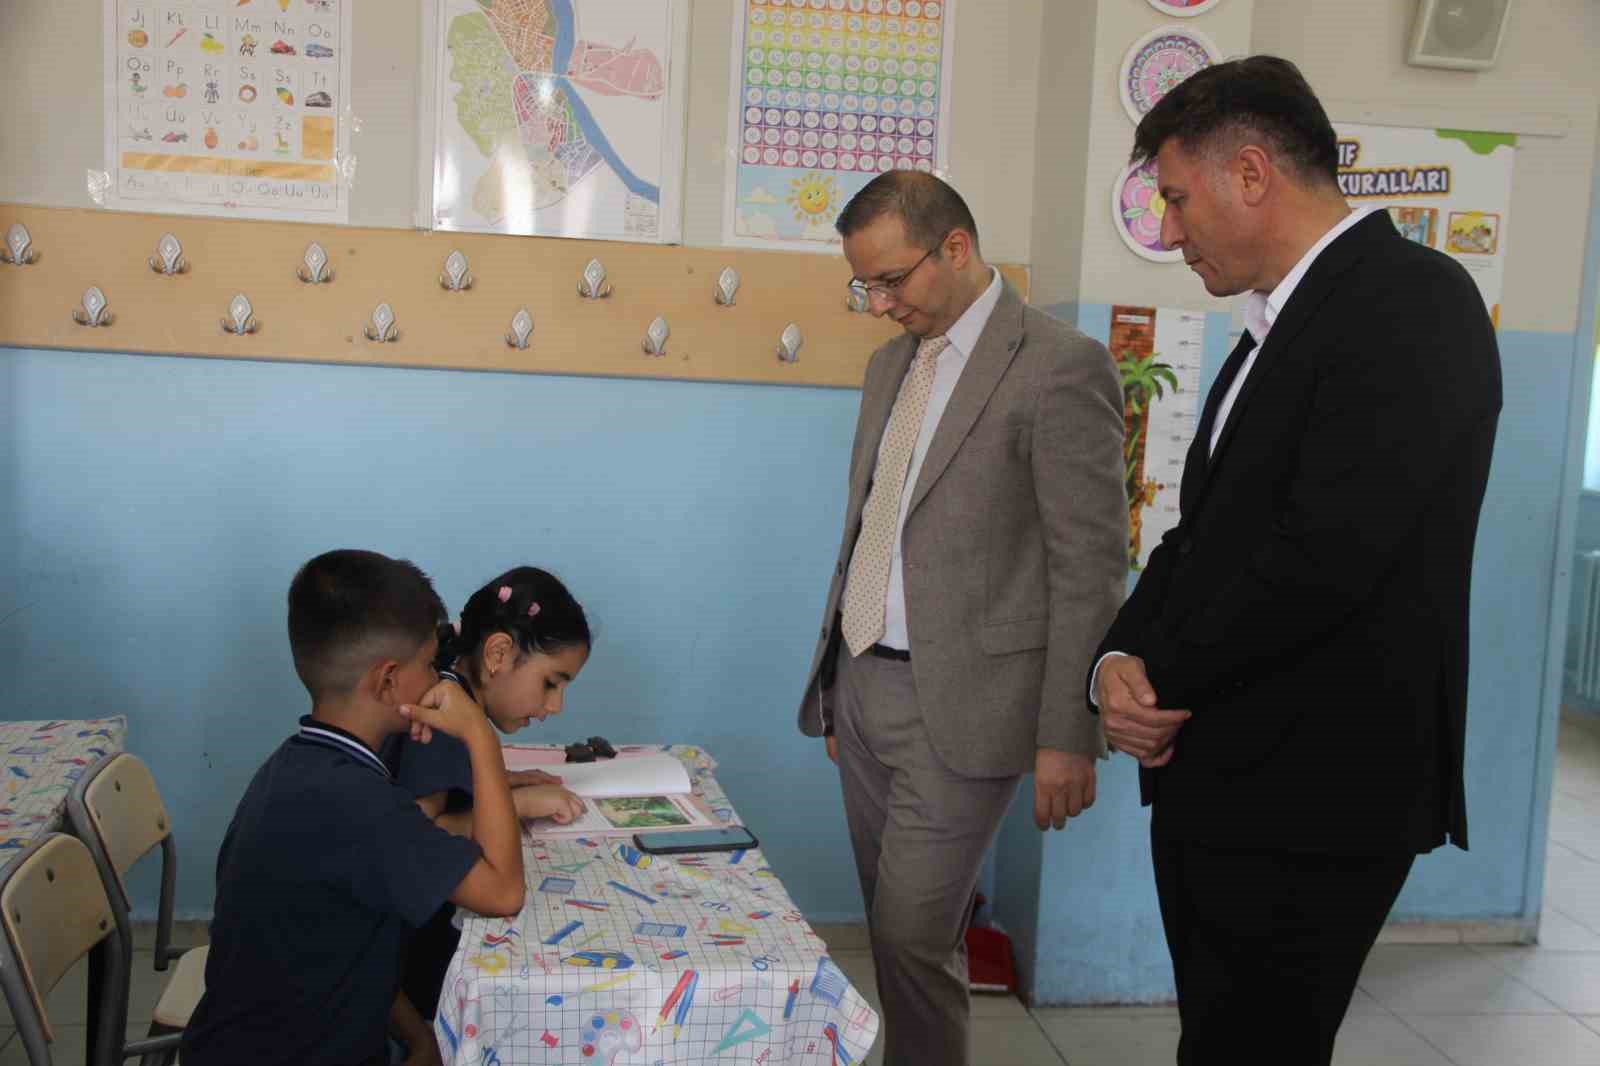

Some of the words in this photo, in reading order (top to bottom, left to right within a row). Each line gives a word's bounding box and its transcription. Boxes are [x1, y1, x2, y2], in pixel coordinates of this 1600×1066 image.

[235, 18, 261, 33] Mm
[274, 20, 296, 36] Nn
[167, 60, 184, 79] Pp
[1336, 143, 1359, 167] IF
[1337, 170, 1448, 195] KURALLARI
